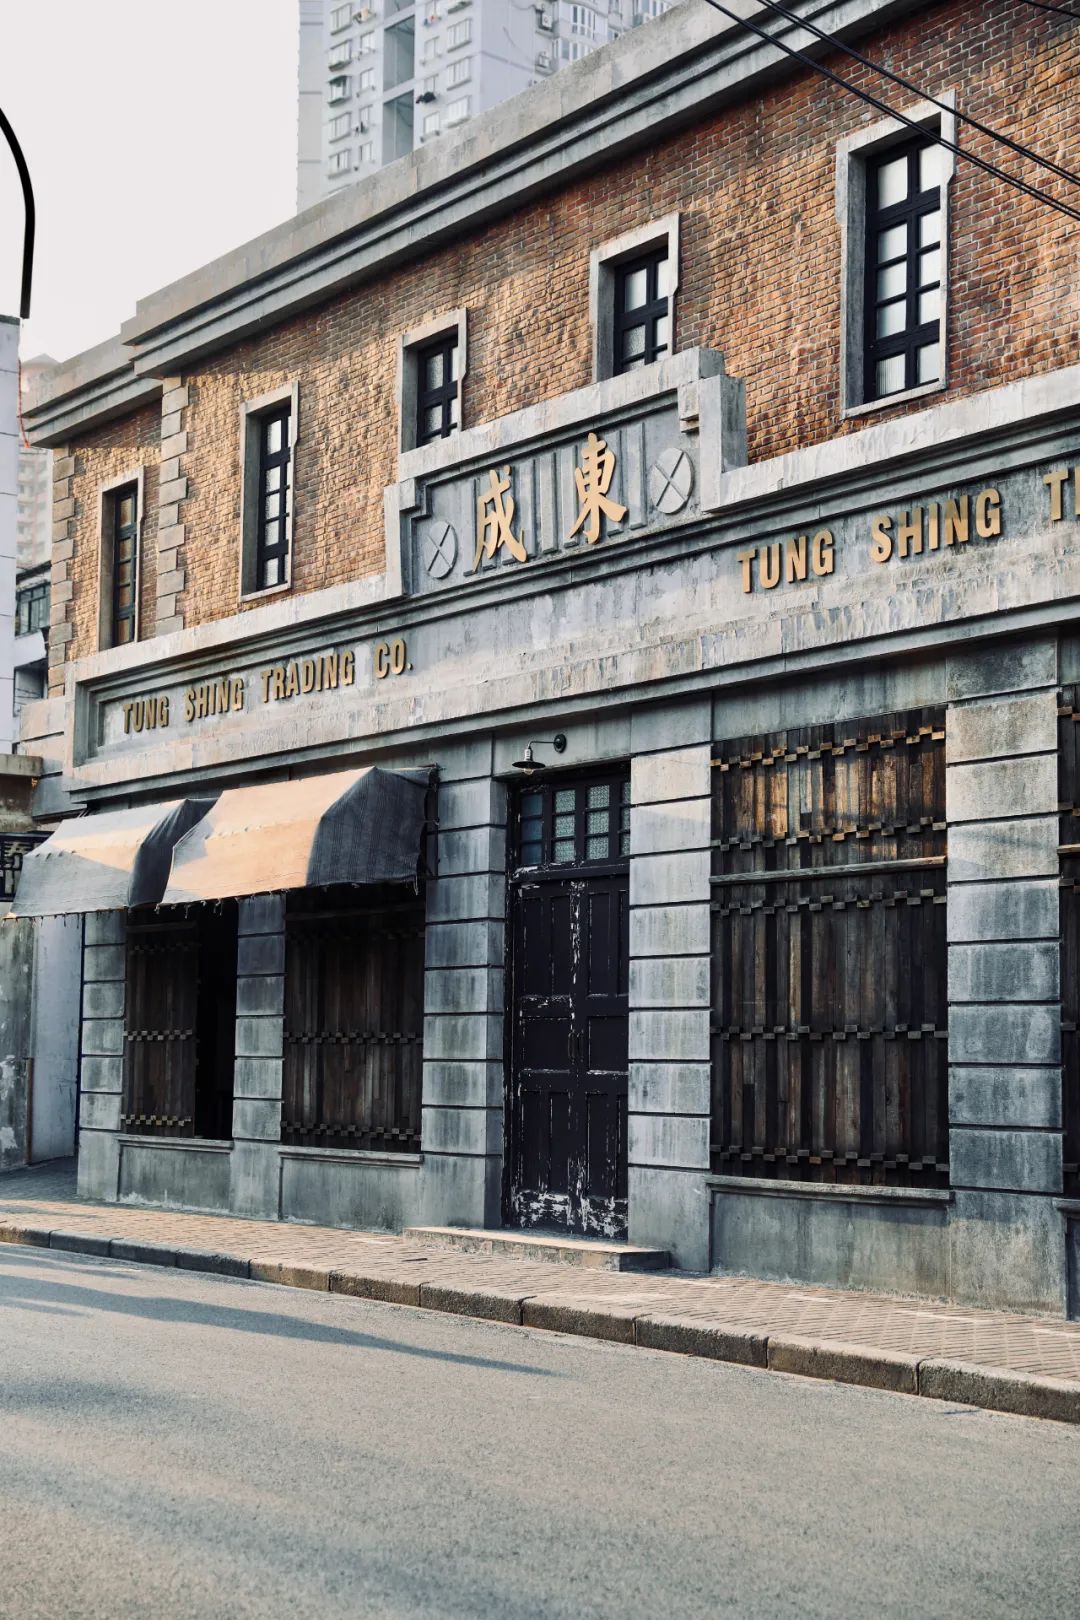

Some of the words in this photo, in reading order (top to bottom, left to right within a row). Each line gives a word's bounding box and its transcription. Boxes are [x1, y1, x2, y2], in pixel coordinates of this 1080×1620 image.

[736, 528, 835, 593] TUNG
[870, 488, 1001, 563] SHING
[1043, 466, 1080, 521] T
[123, 696, 169, 734] TUNG
[184, 678, 244, 722] SHING
[260, 650, 356, 703] TRADING
[373, 639, 413, 679] CO.
